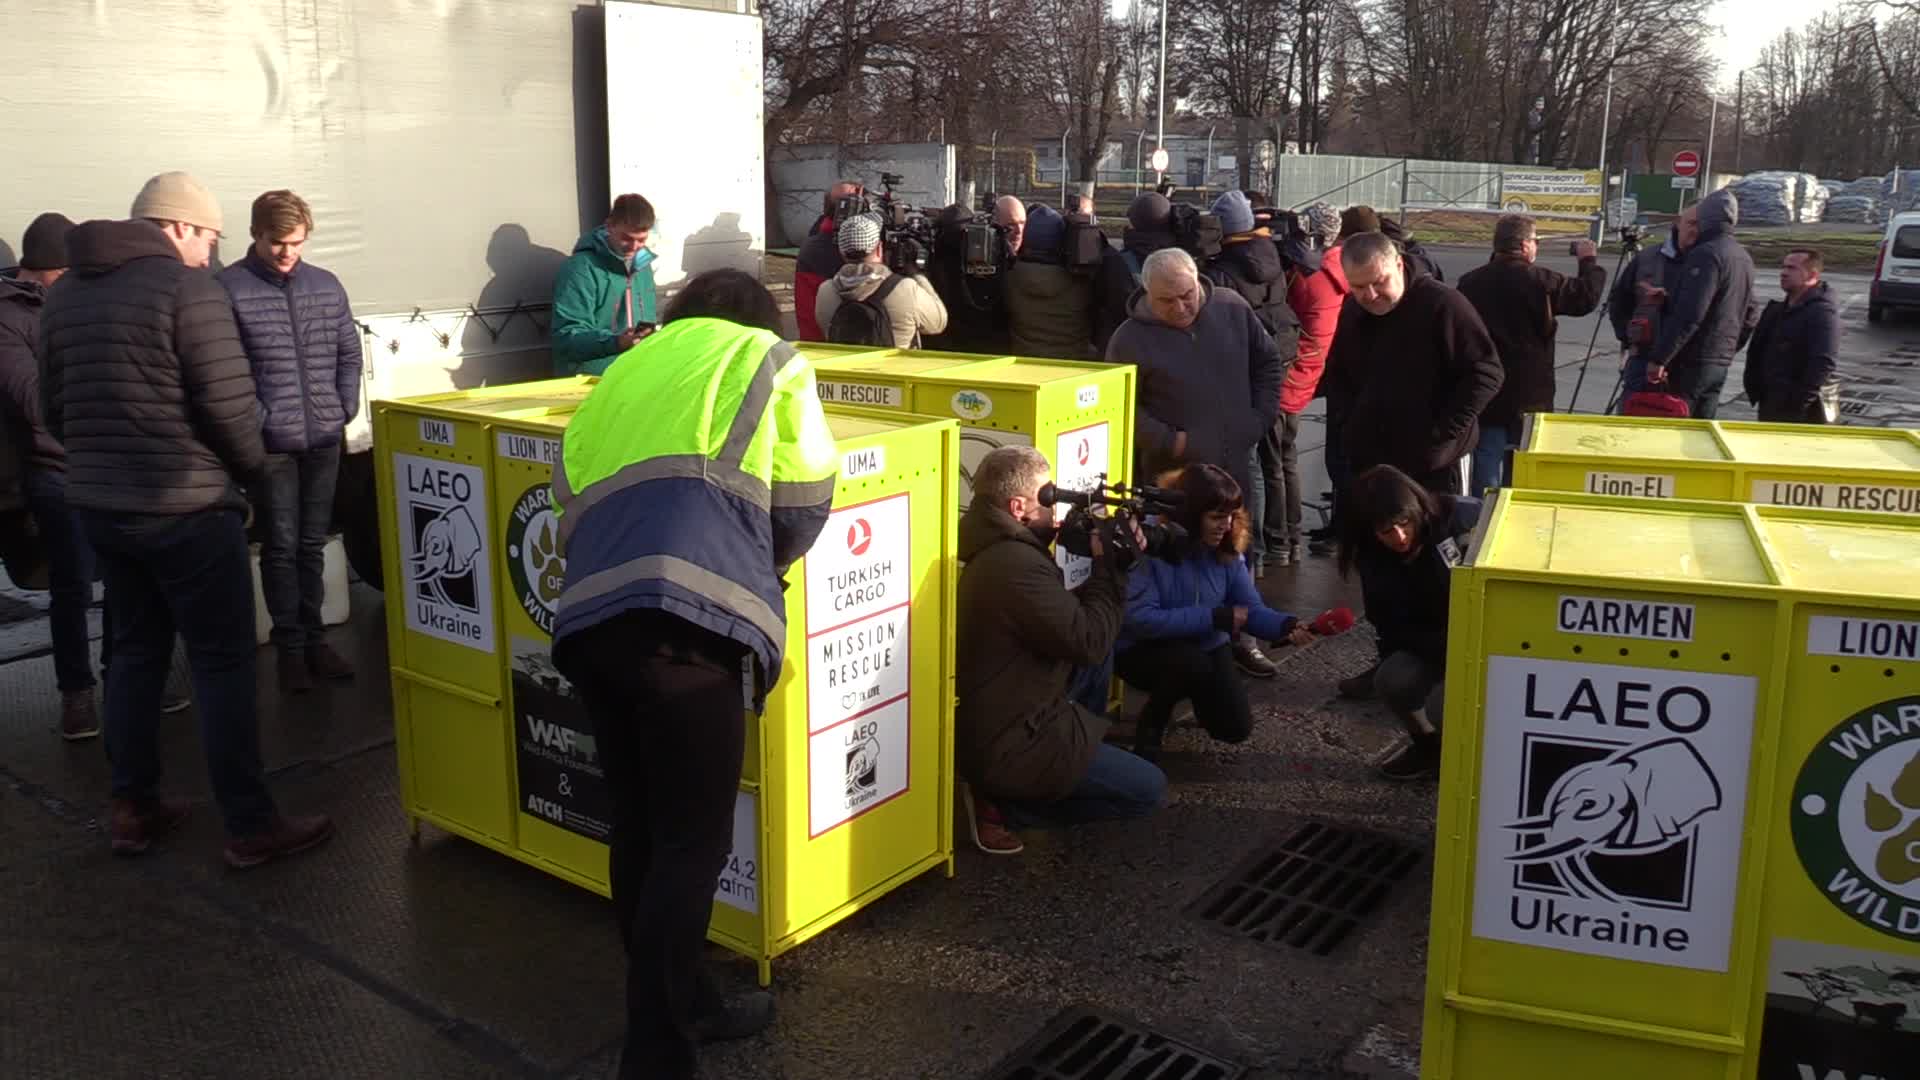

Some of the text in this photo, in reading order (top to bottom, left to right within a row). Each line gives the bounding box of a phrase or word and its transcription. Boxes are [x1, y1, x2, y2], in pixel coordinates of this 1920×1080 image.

[841, 384, 890, 404] RESCUE
[424, 421, 449, 443] UMA
[508, 436, 537, 460] LION
[848, 451, 877, 475] UMA
[407, 463, 471, 502] LAEO
[1590, 474, 1667, 498] Lion-EL
[1772, 482, 1824, 507] LION
[827, 560, 892, 593] TURKISH
[834, 581, 886, 612] CARGO
[417, 603, 481, 640] Ukraine
[1559, 598, 1694, 641] CARMEN
[823, 622, 895, 663] MISSION
[1839, 621, 1918, 658] LION
[829, 648, 892, 688] RESCUE
[1524, 672, 1711, 734] LAEO
[844, 721, 878, 746] LAEO
[558, 773, 573, 797] &
[844, 789, 877, 810] Ukraine
[528, 795, 563, 822] ATCH
[1511, 896, 1690, 952] Ukraine
